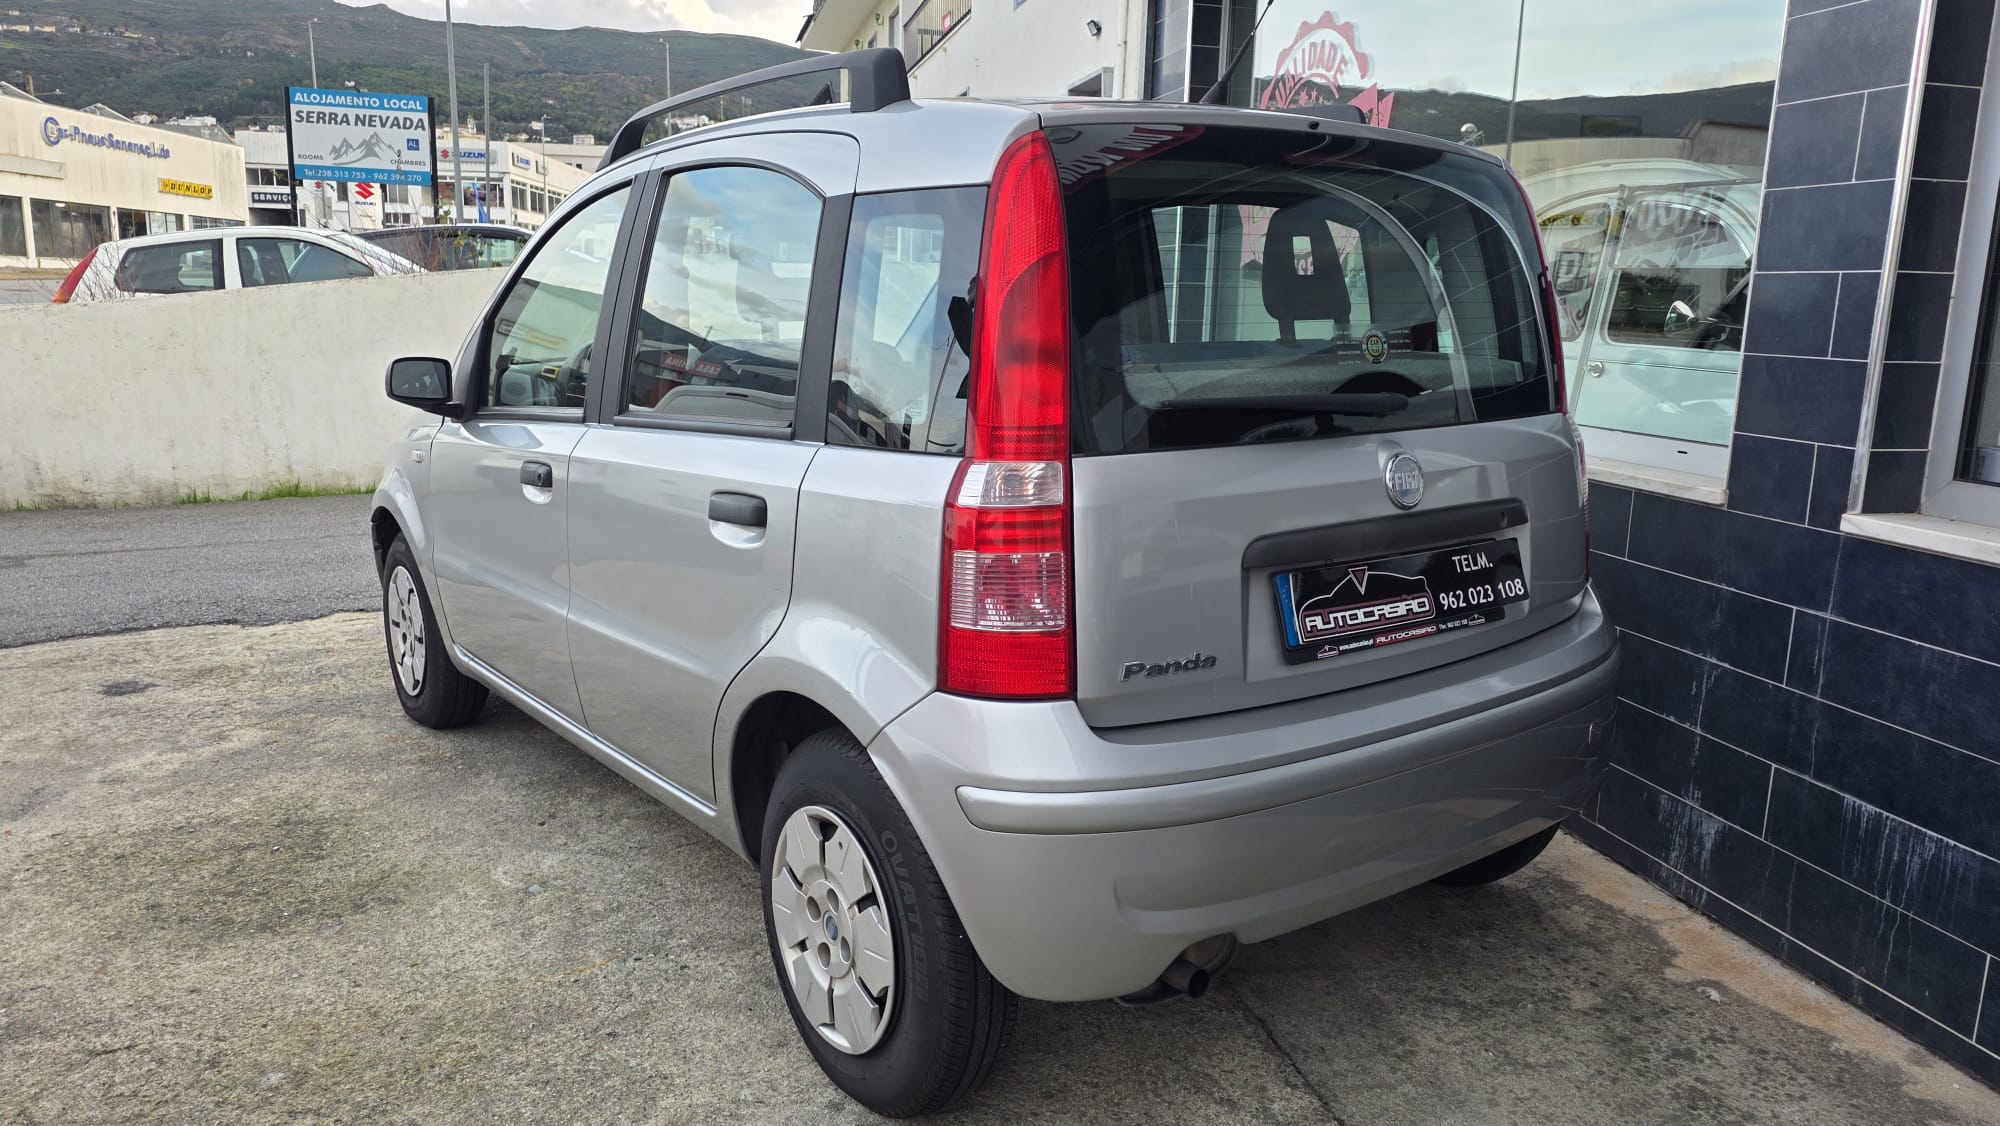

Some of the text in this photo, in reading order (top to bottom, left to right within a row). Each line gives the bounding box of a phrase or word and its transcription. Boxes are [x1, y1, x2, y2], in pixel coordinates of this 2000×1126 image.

[1270, 40, 1348, 109] UALIDADE
[294, 92, 423, 110] ALOJAMENTO LOCAL
[294, 110, 426, 131] SERRA NEVADA
[297, 153, 324, 161] ROOMS
[390, 159, 426, 167] CHAMBRES
[335, 169, 349, 178] 313
[351, 170, 366, 178] 753
[373, 171, 388, 180] 962
[407, 173, 422, 182] 370
[170, 182, 212, 195] DUNLOP
[253, 193, 291, 202] SERVIÇ
[1394, 471, 1419, 490] FIAT
[1452, 551, 1493, 573] TELM.
[1439, 578, 1525, 611] 962 023 108
[1120, 651, 1217, 682] Panda
